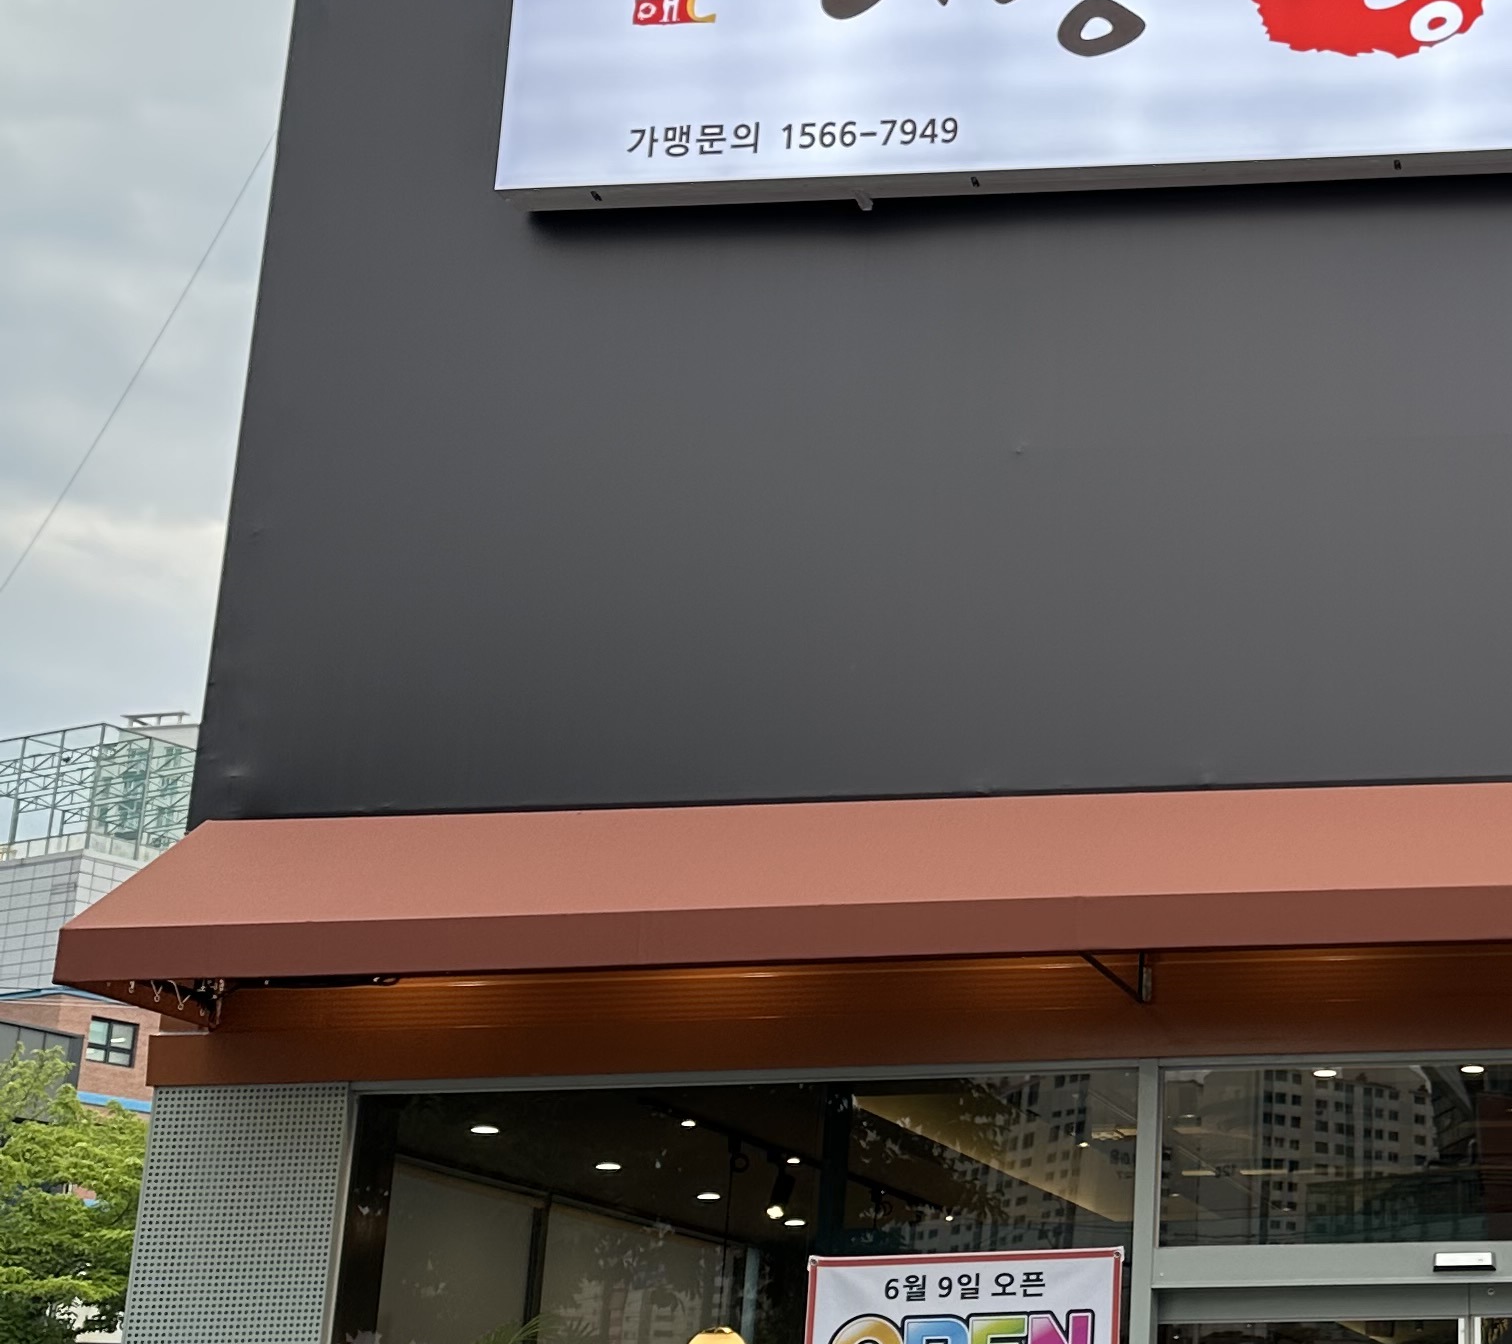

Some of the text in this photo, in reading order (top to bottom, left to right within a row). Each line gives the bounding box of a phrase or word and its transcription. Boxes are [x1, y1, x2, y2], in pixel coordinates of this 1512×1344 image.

[626, 117, 958, 158] 가맹문의 1566-7949
[884, 1271, 1046, 1302] 6월 9일 오픈
